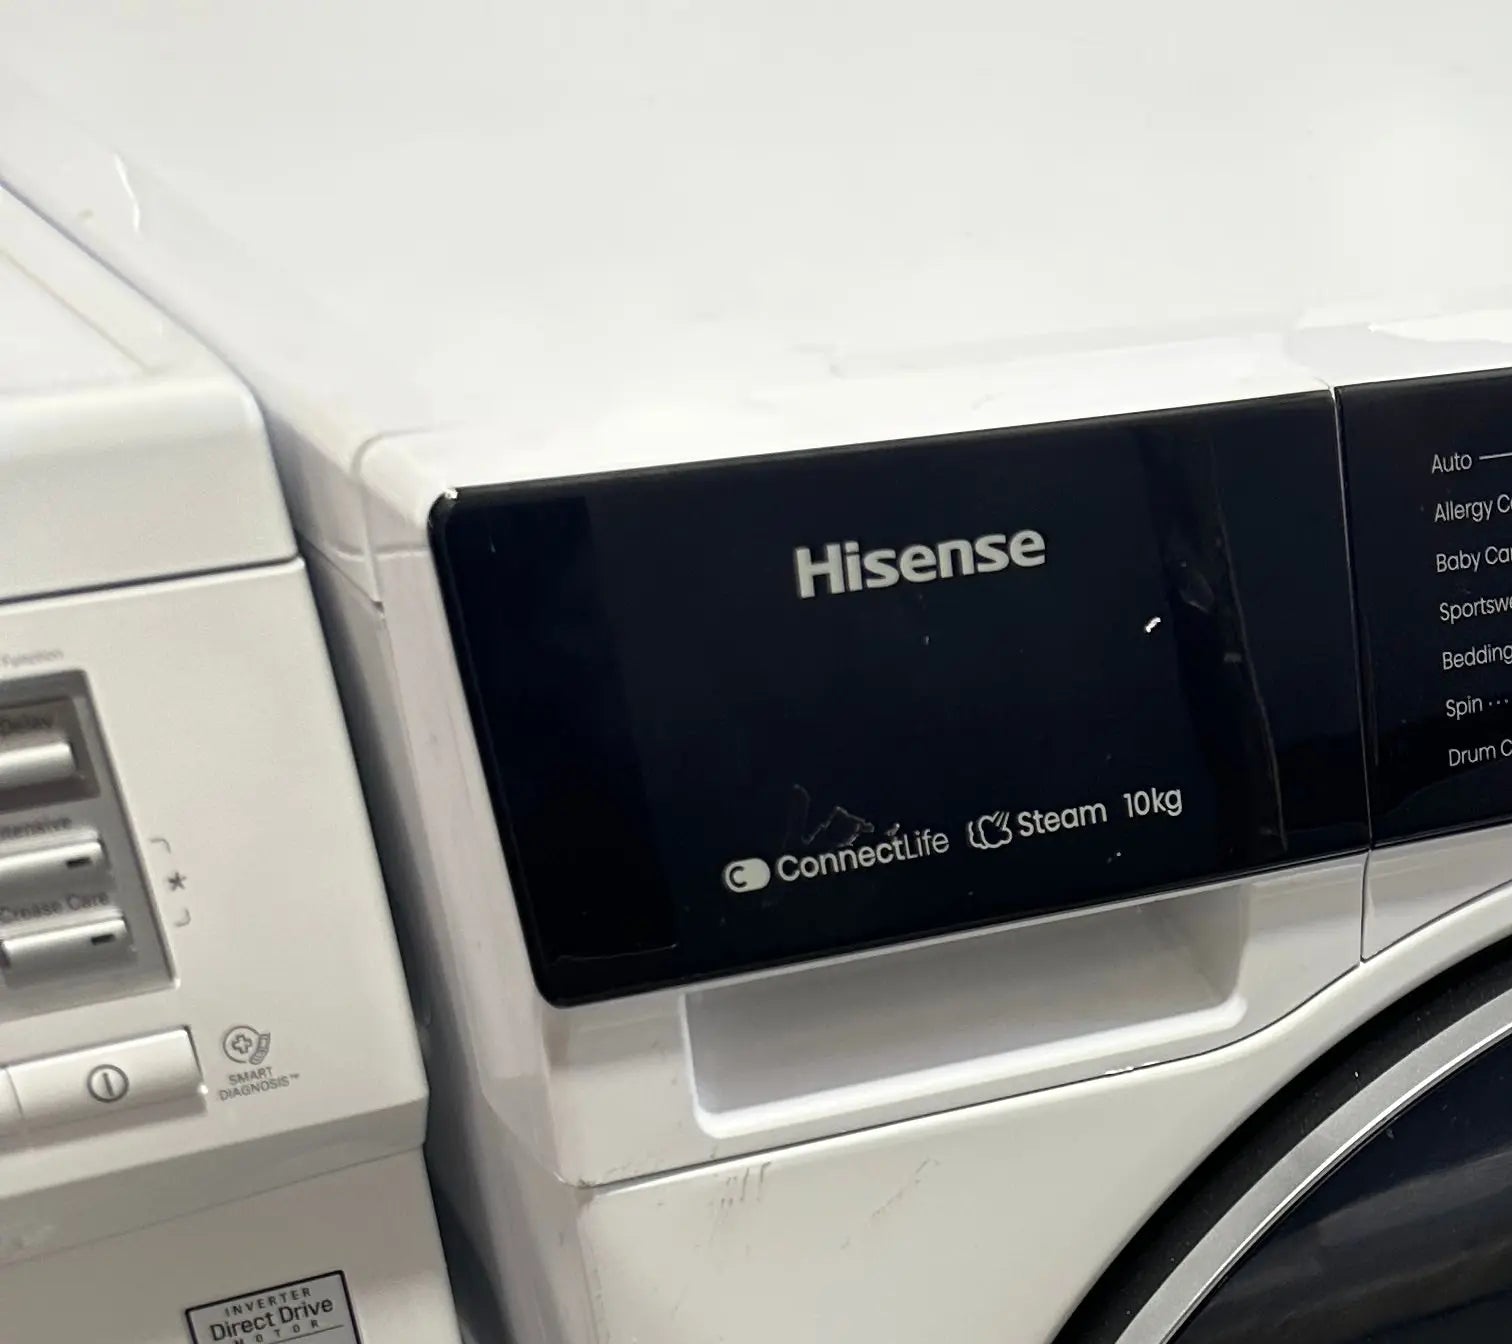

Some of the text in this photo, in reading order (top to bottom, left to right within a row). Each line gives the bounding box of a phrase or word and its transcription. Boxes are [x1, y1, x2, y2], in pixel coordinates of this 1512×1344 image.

[1431, 453, 1473, 474] Auto
[1434, 499, 1493, 523] Allergy
[795, 529, 1046, 599] Hisense
[1436, 550, 1481, 573] Baby
[1445, 695, 1483, 720] Spin
[1448, 744, 1496, 767] Drum
[0, 816, 72, 840] ntensive
[775, 785, 1183, 882] ConnectLife Steam 10kg
[229, 1066, 272, 1086] SMART
[224, 1287, 312, 1317] INVERTER
[209, 1299, 333, 1341] Direct Drive
